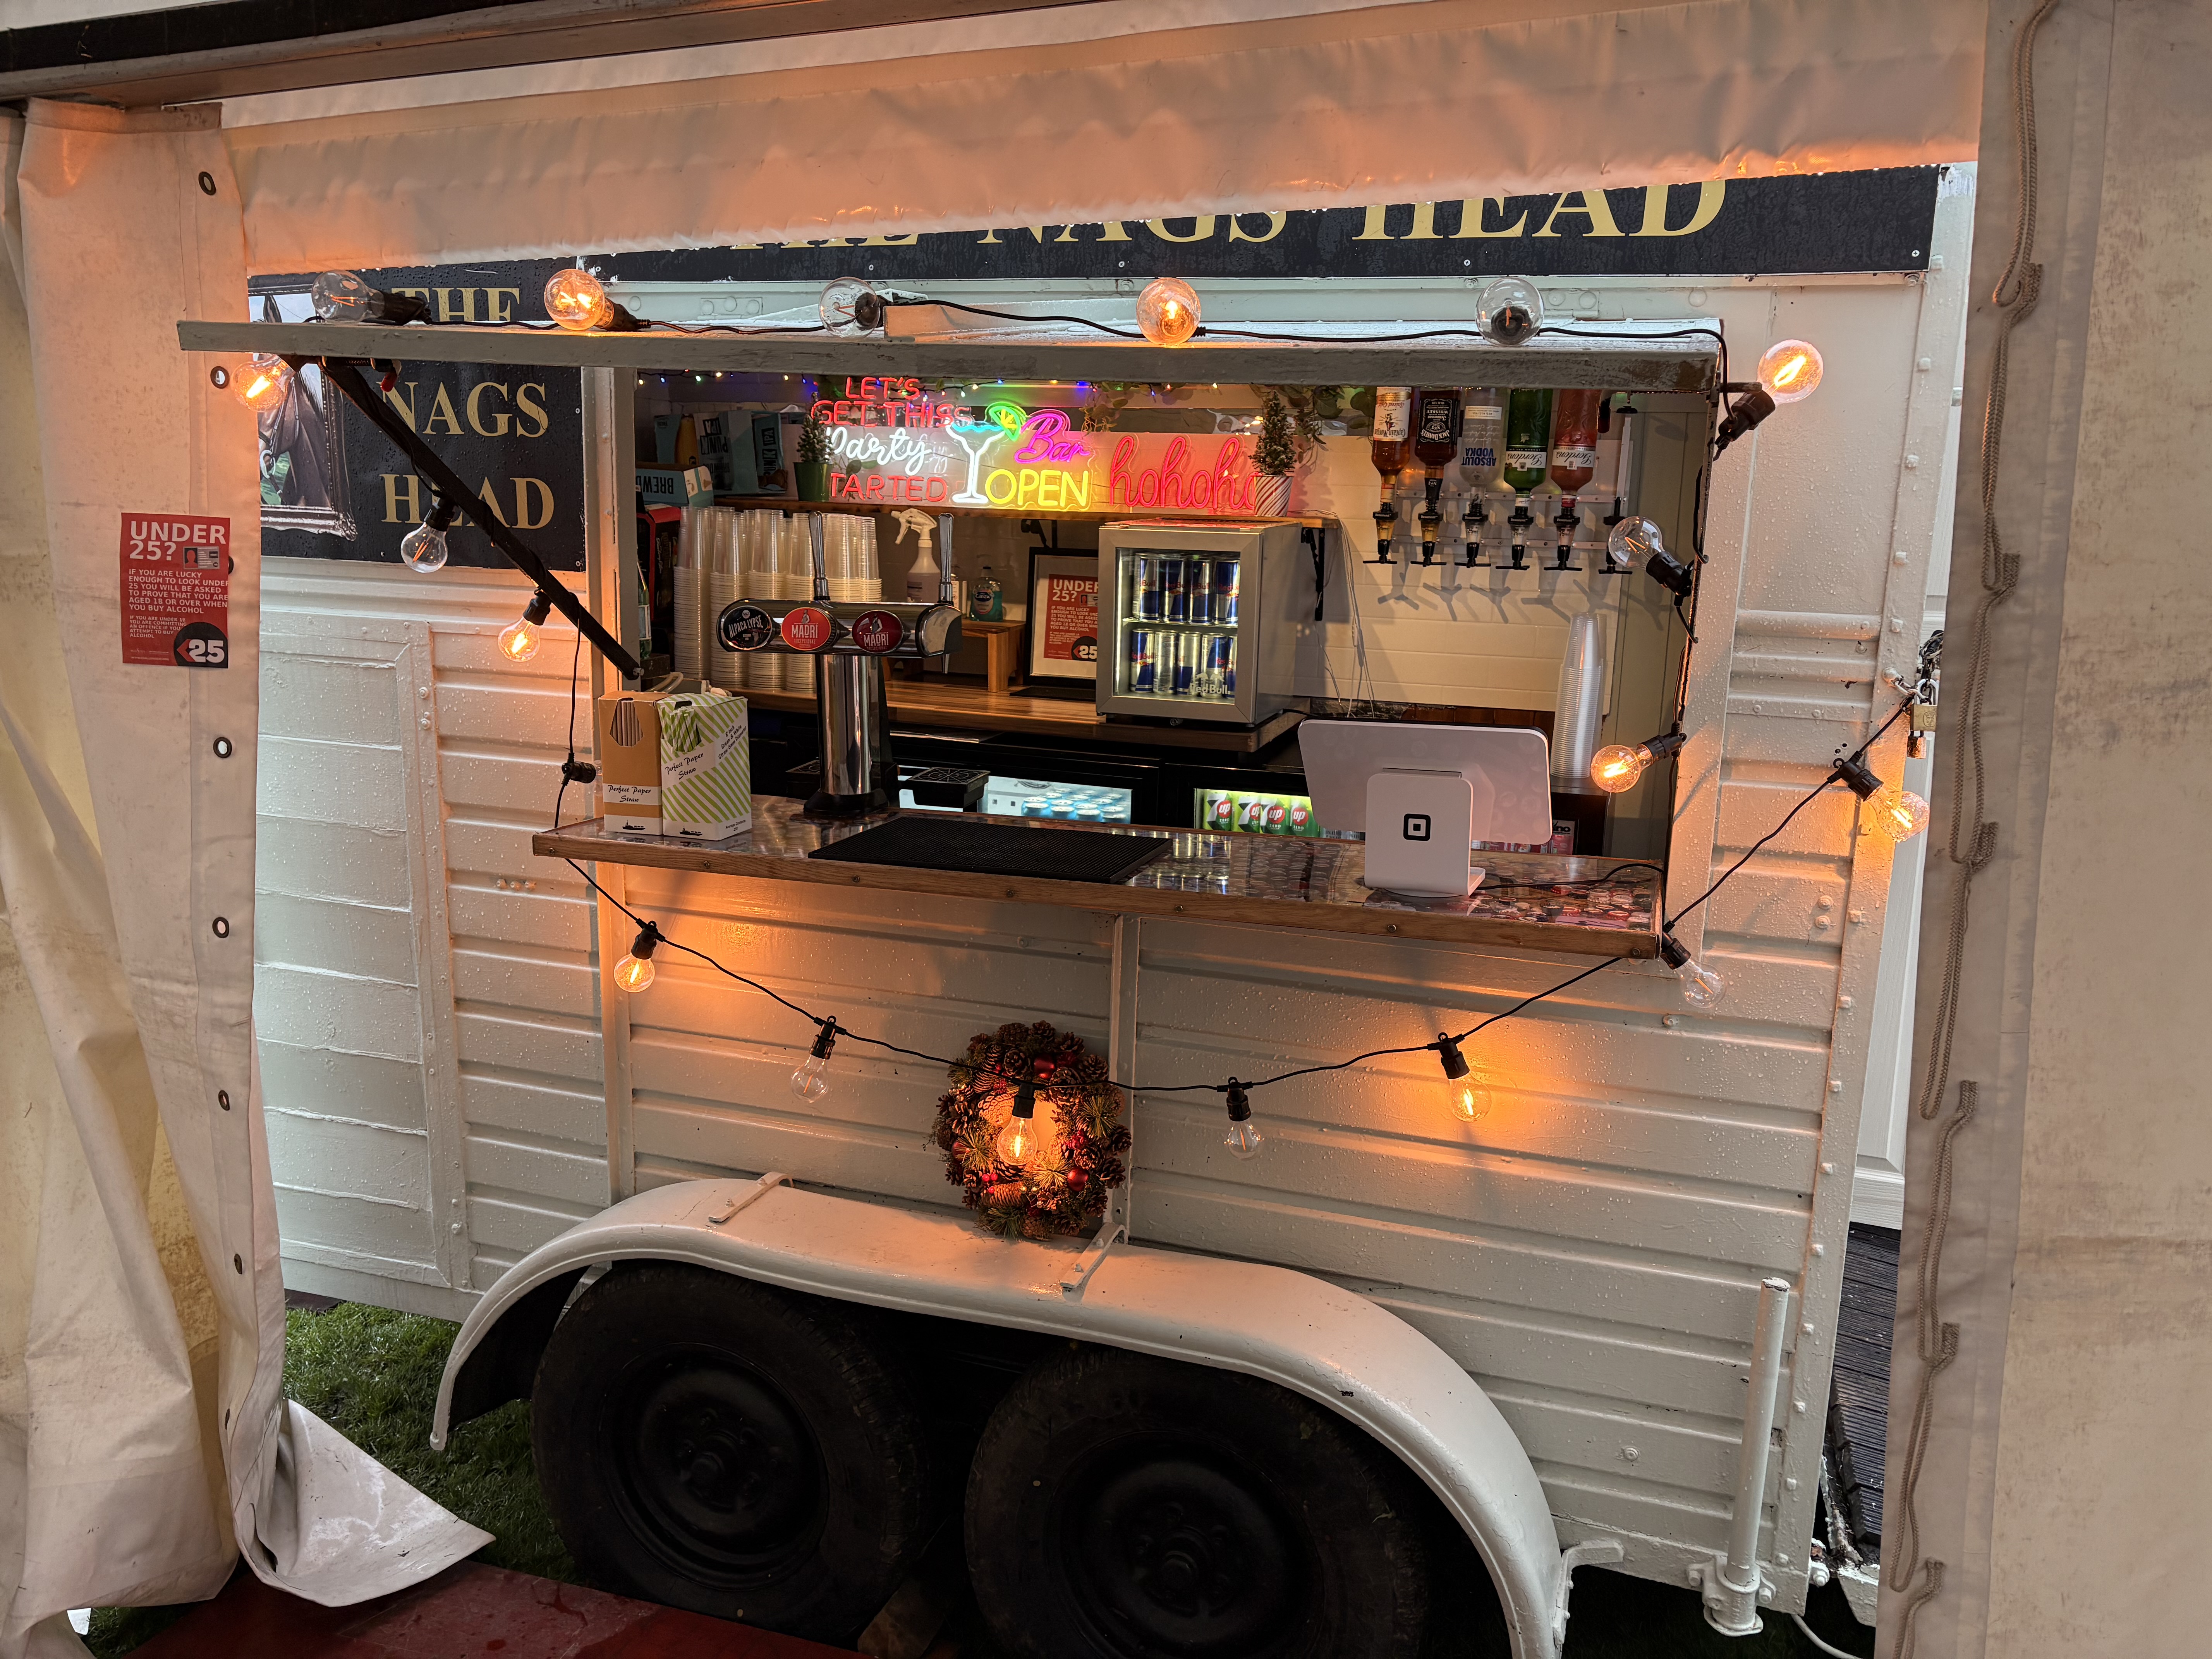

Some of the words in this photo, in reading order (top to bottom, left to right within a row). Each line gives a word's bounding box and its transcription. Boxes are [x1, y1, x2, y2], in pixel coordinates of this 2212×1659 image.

[846, 377, 920, 400] LET'S
[376, 381, 548, 438] NAGS
[811, 400, 873, 426] GET
[883, 401, 954, 427] THIS
[762, 428, 776, 446] IPA
[1014, 413, 1091, 464] Bar
[1439, 430, 1449, 439] JACK
[826, 426, 932, 476] Party
[1461, 457, 1496, 466] ABSOLUT
[1465, 448, 1494, 457] VODKA
[830, 473, 947, 502] TARTED
[985, 469, 1089, 507] OPEN
[380, 474, 554, 529] HAD
[131, 521, 226, 544] UNDER
[130, 540, 176, 561] 25?
[1053, 590, 1077, 602] 25?
[1190, 683, 1207, 693] Red
[1210, 684, 1228, 694] Bull
[665, 761, 683, 775] Perfect
[684, 753, 703, 766] Paper
[678, 768, 696, 780] Straw
[608, 785, 629, 793] Perfect
[632, 787, 651, 795] Paper
